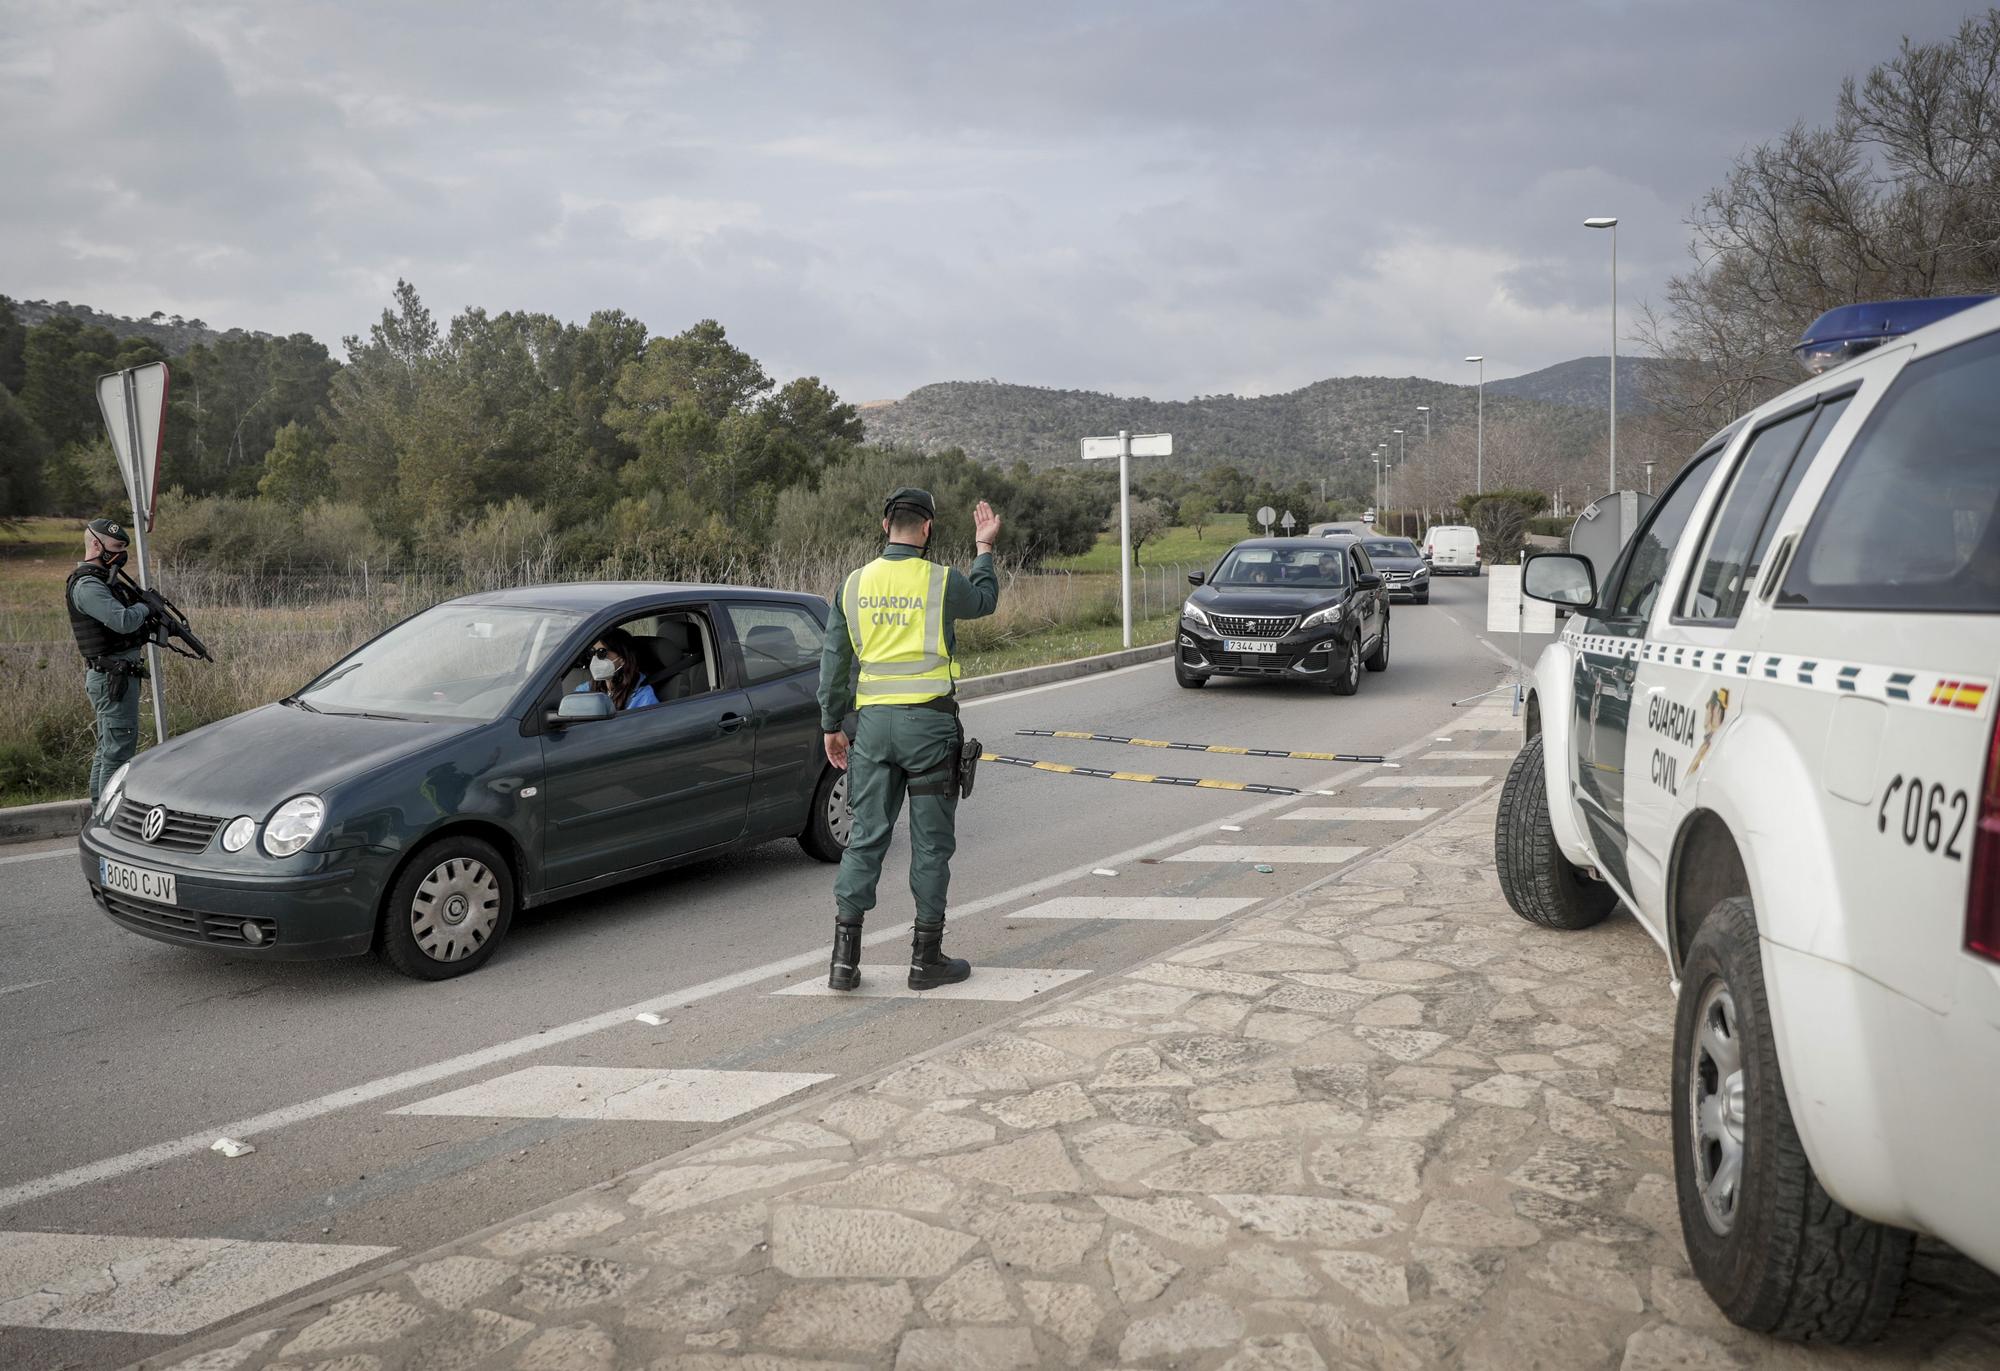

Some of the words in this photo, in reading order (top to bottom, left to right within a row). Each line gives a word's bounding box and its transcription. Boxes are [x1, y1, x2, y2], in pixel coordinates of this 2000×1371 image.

[858, 596, 924, 610] GUARDIA
[871, 612, 909, 626] CIVIL
[1230, 641, 1253, 650] 7344
[1257, 642, 1274, 652] JYY
[1648, 694, 1697, 749] GUARDIA
[1651, 747, 1678, 797] CIVIL
[1902, 776, 1968, 863] 062
[107, 863, 138, 892] 8060
[142, 873, 171, 900] CJV
